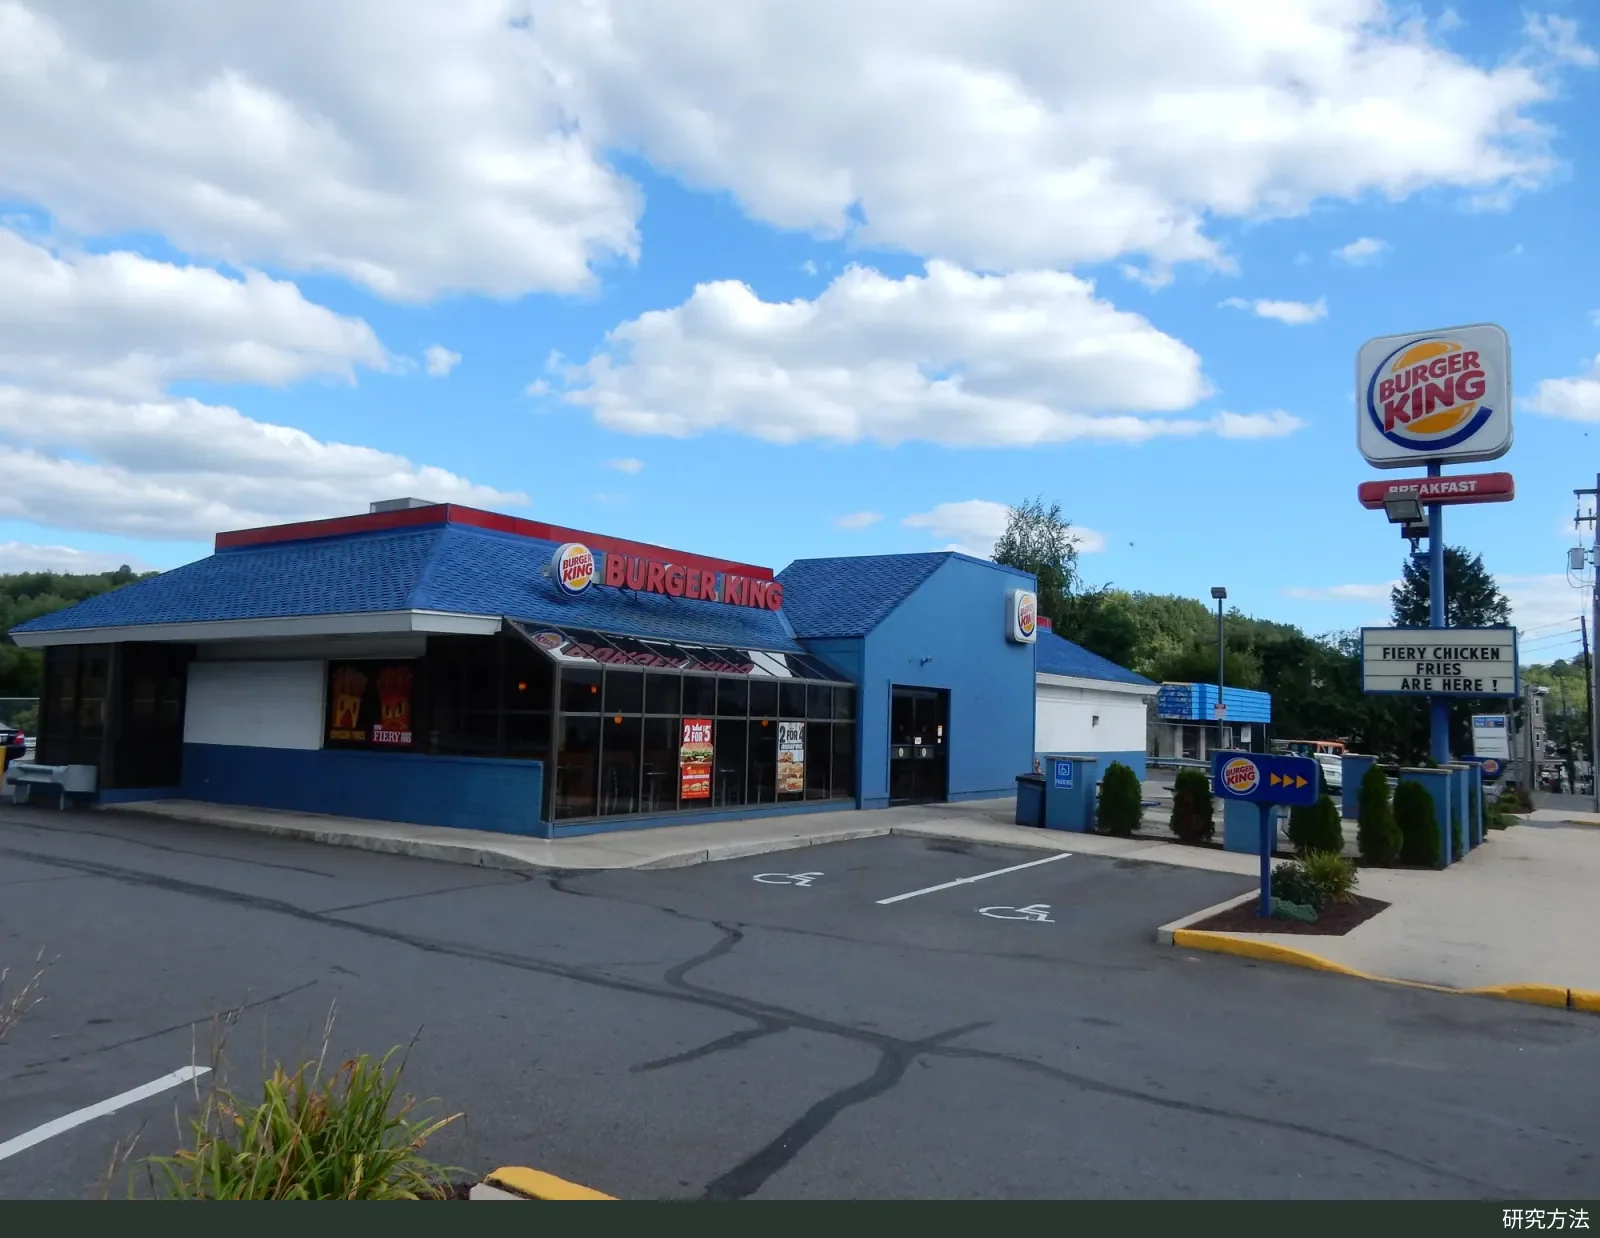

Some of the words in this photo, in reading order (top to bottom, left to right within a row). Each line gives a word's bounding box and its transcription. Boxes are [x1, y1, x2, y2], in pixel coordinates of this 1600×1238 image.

[1379, 351, 1481, 403] BURGER
[1384, 370, 1486, 432] KING
[562, 553, 593, 570] BURGER
[562, 563, 593, 583] KING
[606, 552, 717, 601] BURGER
[723, 573, 783, 611] KING
[1382, 647, 1427, 660] FIERY
[1433, 647, 1500, 660] CHICKEN
[1416, 663, 1462, 675] FRIES
[1401, 678, 1433, 691] ARE
[1442, 678, 1483, 691] HERE
[1492, 679, 1498, 692] !
[373, 731, 401, 743] FIERY
[684, 725, 691, 742] 2
[691, 731, 703, 742] FOR
[779, 725, 786, 742] 2
[786, 730, 798, 741] FOR
[1225, 765, 1255, 776] BURGER
[1227, 772, 1256, 785] KING
